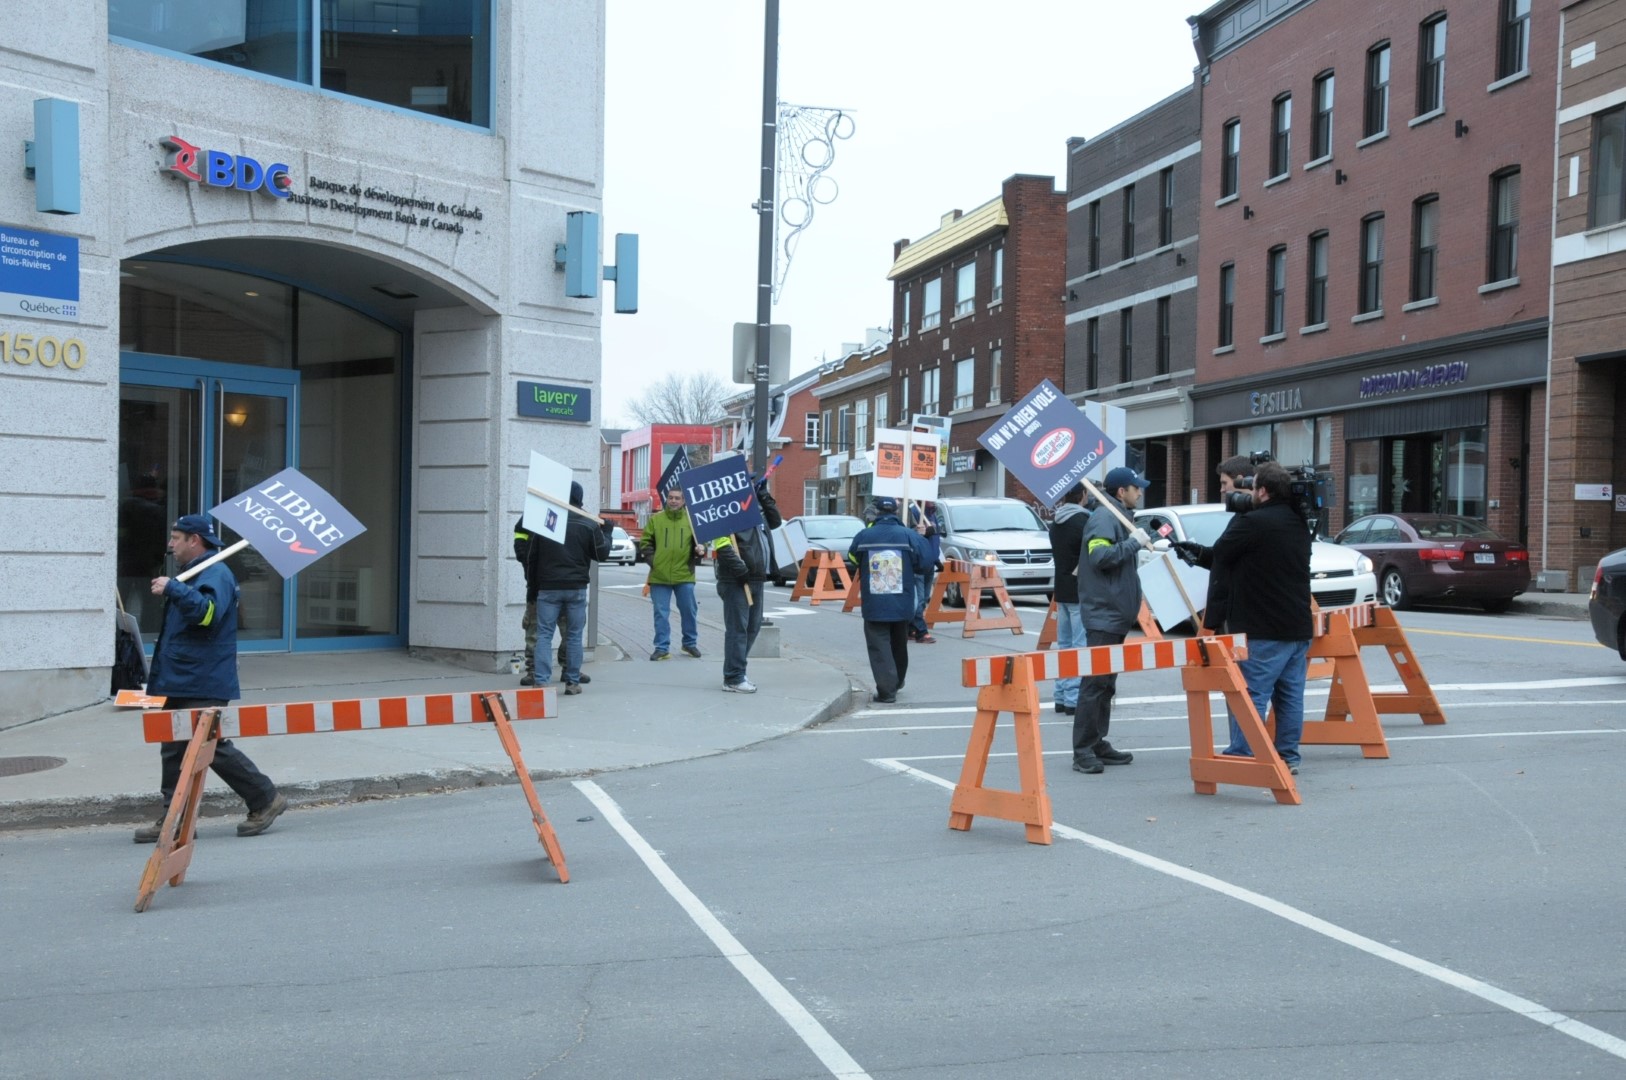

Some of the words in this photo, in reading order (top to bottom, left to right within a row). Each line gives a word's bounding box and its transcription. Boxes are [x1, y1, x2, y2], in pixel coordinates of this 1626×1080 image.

[207, 149, 290, 199] BDC
[287, 191, 328, 209] Business
[330, 199, 393, 221] Development
[395, 212, 418, 226] Bank
[420, 216, 429, 228] of
[432, 218, 464, 234] Canada
[310, 177, 347, 194] Banque
[349, 184, 362, 196] de
[364, 187, 435, 213] développement
[437, 202, 449, 214] du
[451, 205, 483, 221] Canada
[1, 233, 28, 247] Bureau
[29, 238, 40, 247] de
[1, 244, 56, 261] circonscription
[57, 252, 67, 262] de
[2, 255, 51, 271] Trois-Rivières
[20, 300, 61, 315] Québec
[0, 331, 87, 370] 1500
[534, 386, 578, 406] lavery
[549, 406, 574, 415] avocats
[988, 433, 1006, 451] ON
[1012, 404, 1038, 428] RIEN
[1030, 384, 1057, 411] VOLÉ
[660, 456, 688, 503] LIBRE
[686, 470, 750, 506] LIBRE
[1046, 473, 1073, 499] LIBRE
[1070, 451, 1098, 478] NÉGO
[234, 496, 297, 544] NÉGO
[258, 480, 344, 547] LIBRE
[694, 500, 741, 526] NÉGO
